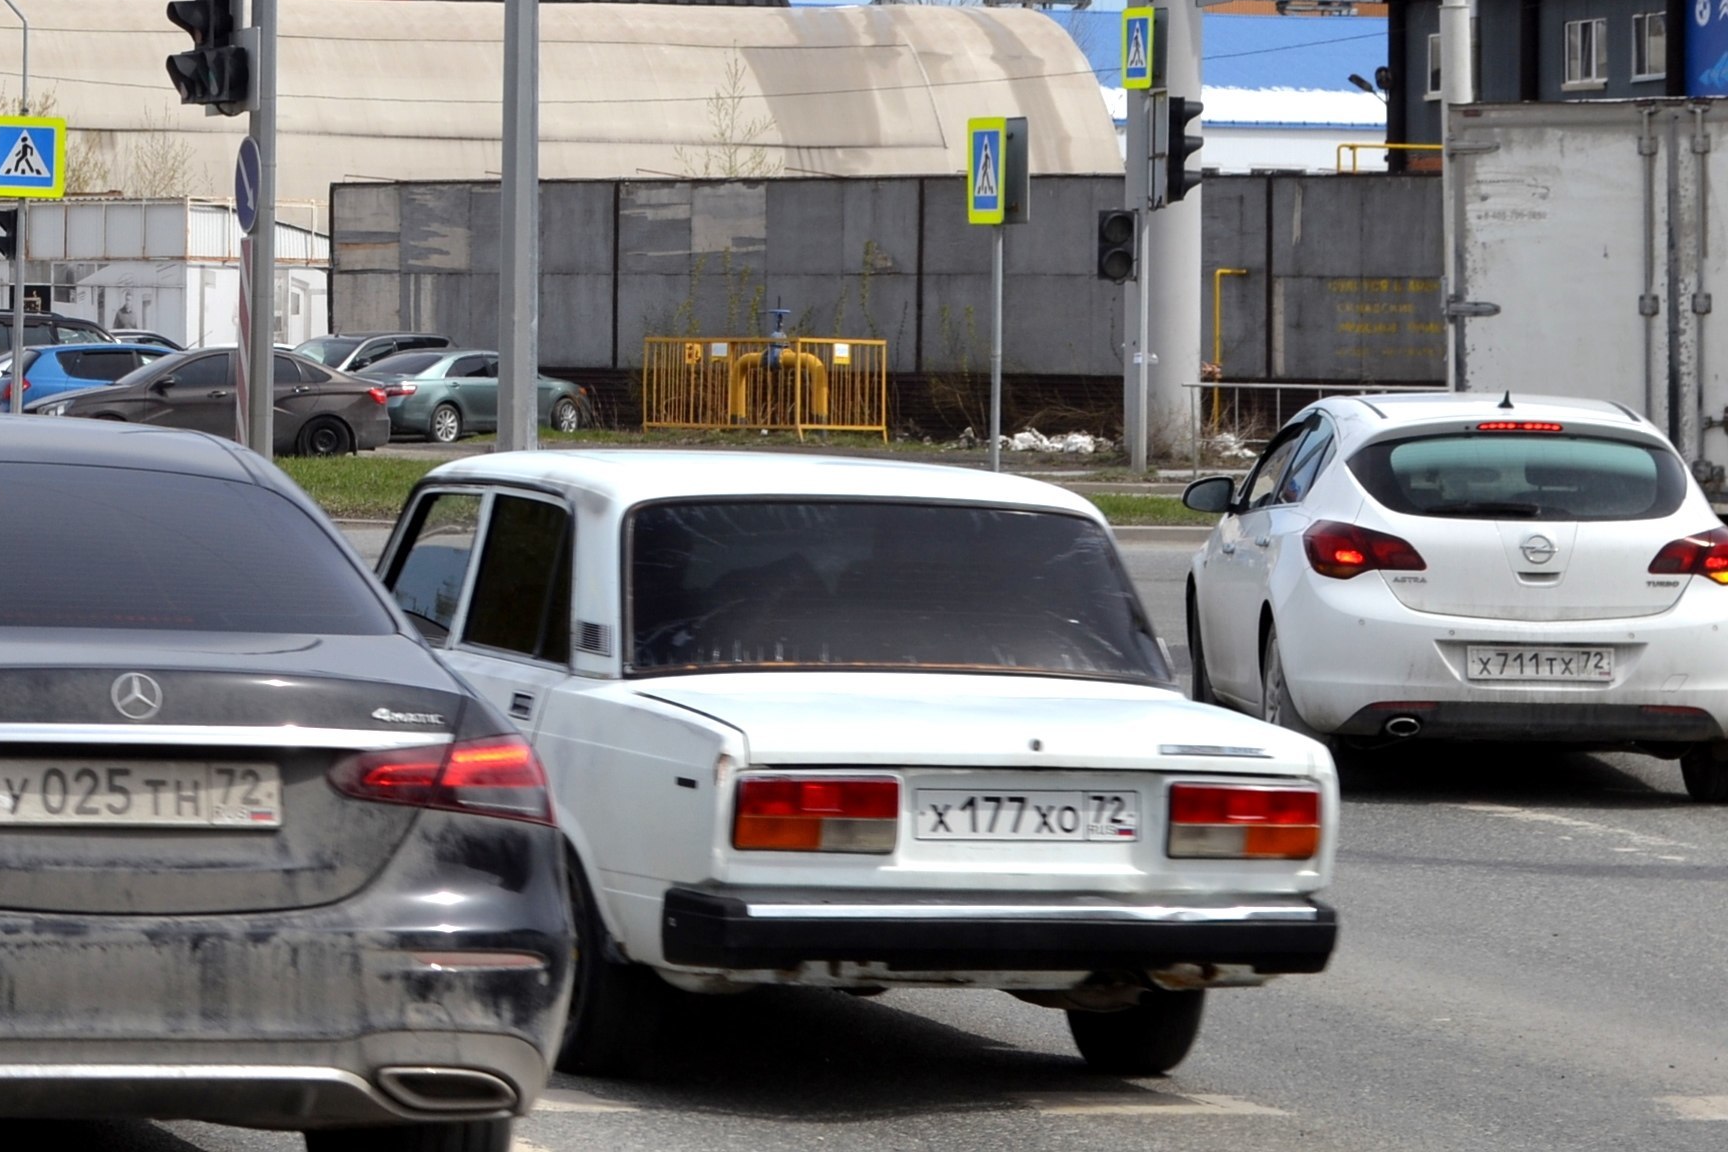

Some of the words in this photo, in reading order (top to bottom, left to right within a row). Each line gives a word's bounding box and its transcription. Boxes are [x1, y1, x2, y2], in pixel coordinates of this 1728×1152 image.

[1646, 580, 1680, 588] TURBO
[1581, 651, 1604, 670] 72
[216, 768, 259, 805] 72
[1089, 795, 1125, 824] 72
